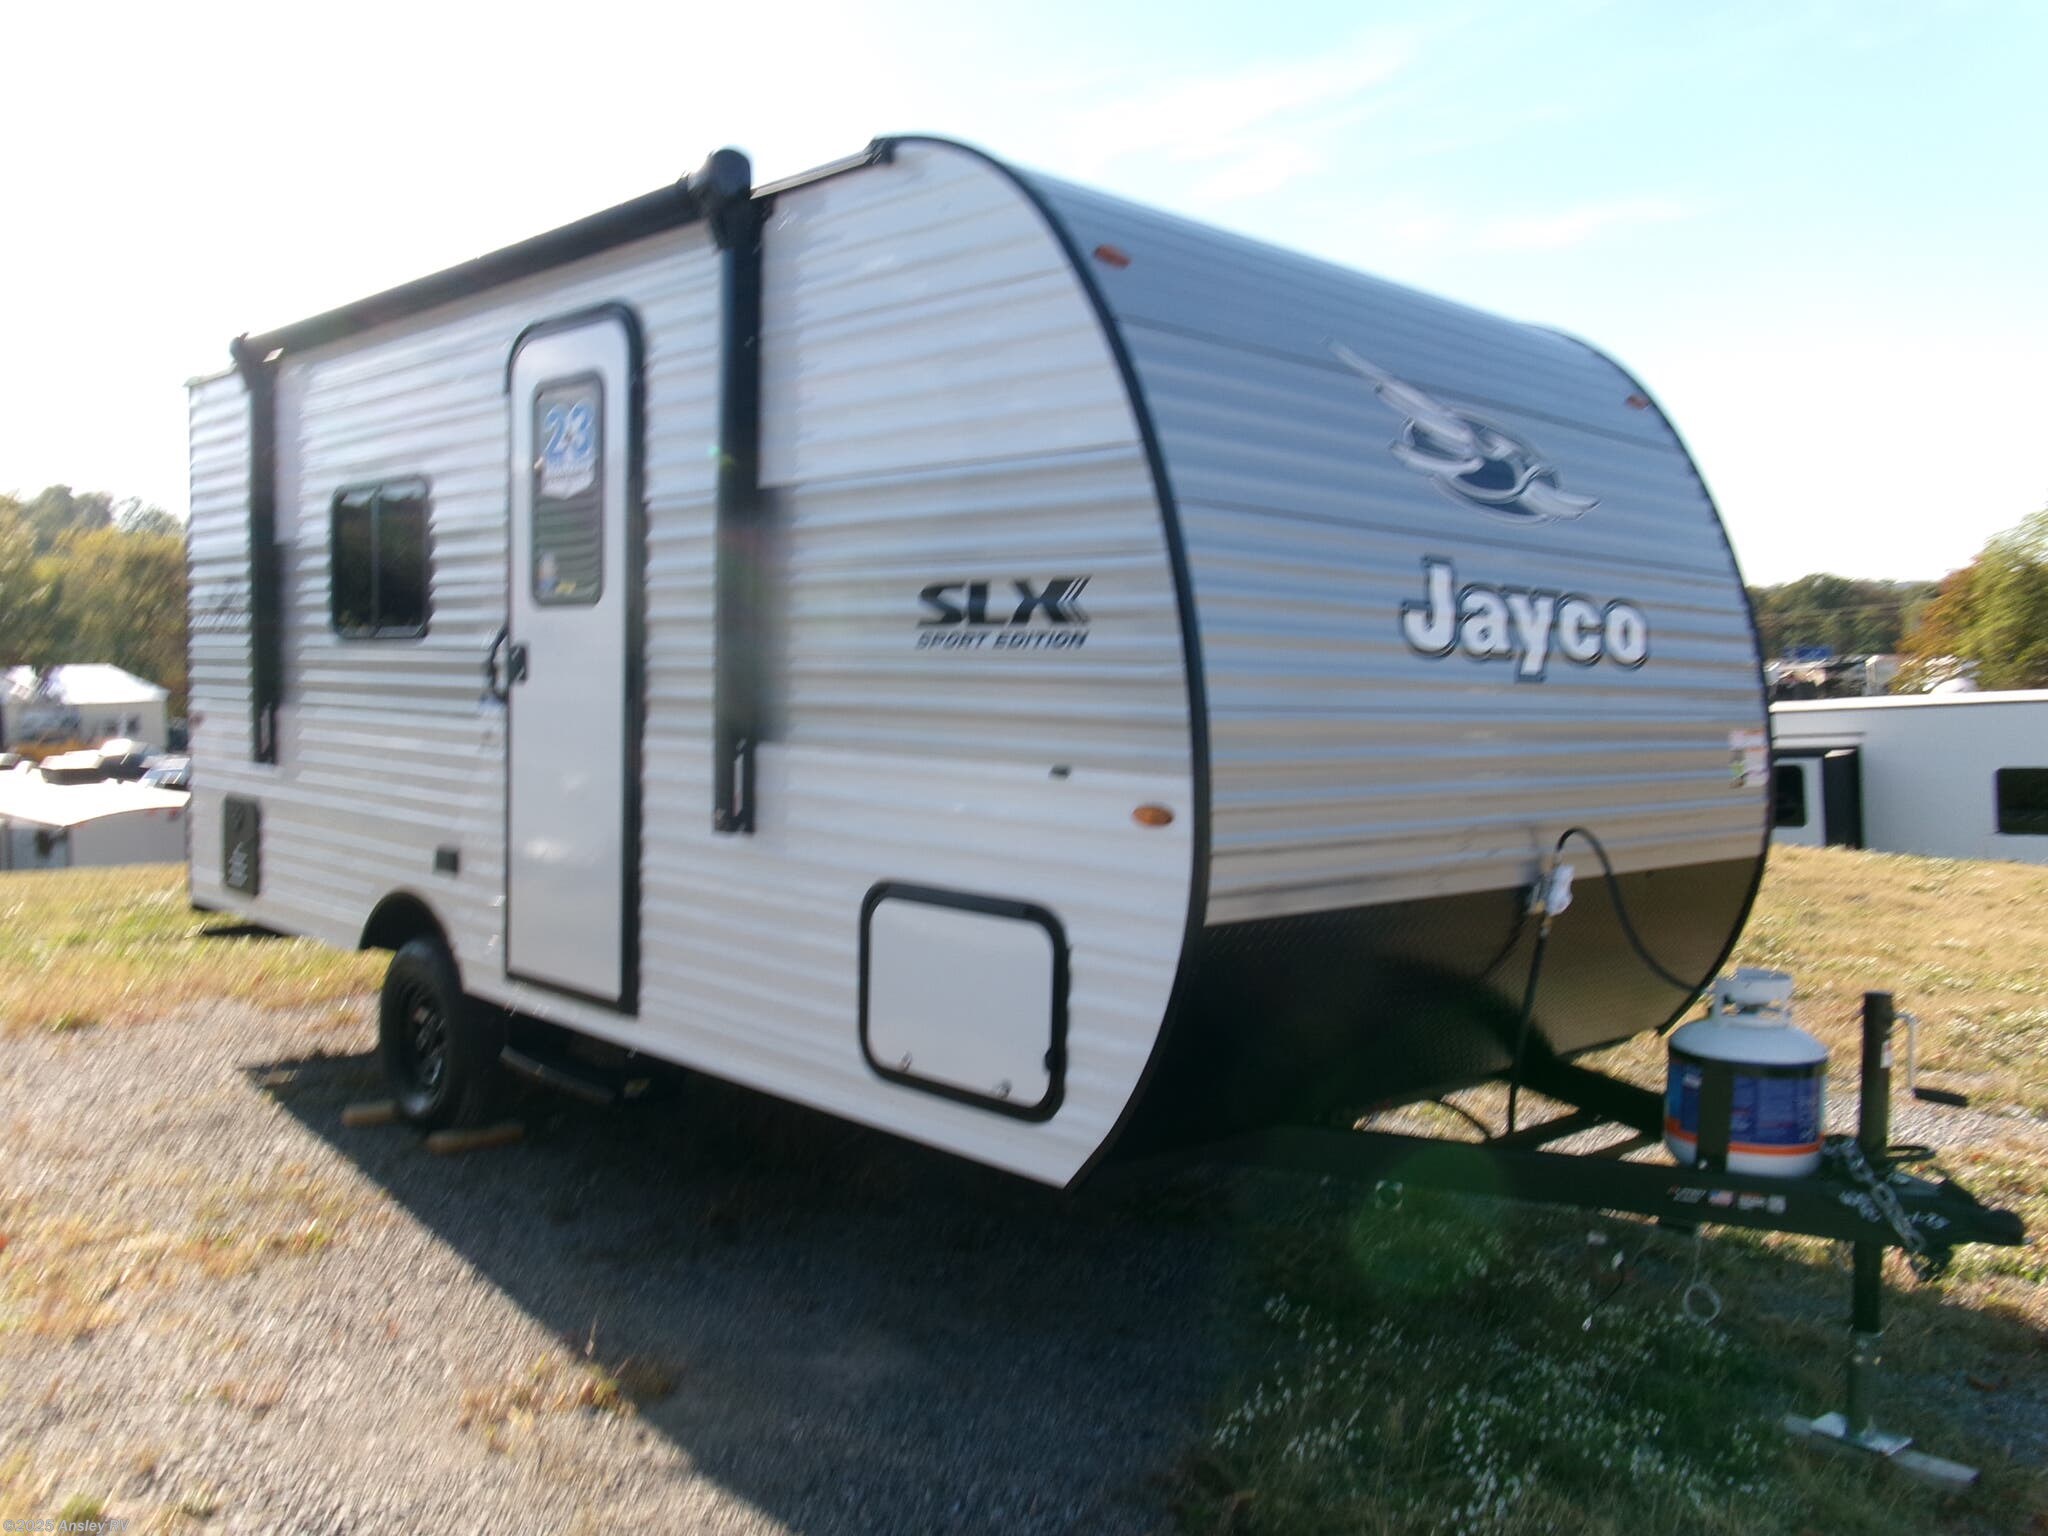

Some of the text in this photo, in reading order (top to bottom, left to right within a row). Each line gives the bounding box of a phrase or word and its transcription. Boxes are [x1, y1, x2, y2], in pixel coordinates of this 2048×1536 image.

[917, 576, 1092, 627] SLX
[1400, 555, 1649, 681] Jayco
[916, 631, 1090, 649] SPORT EDITION
